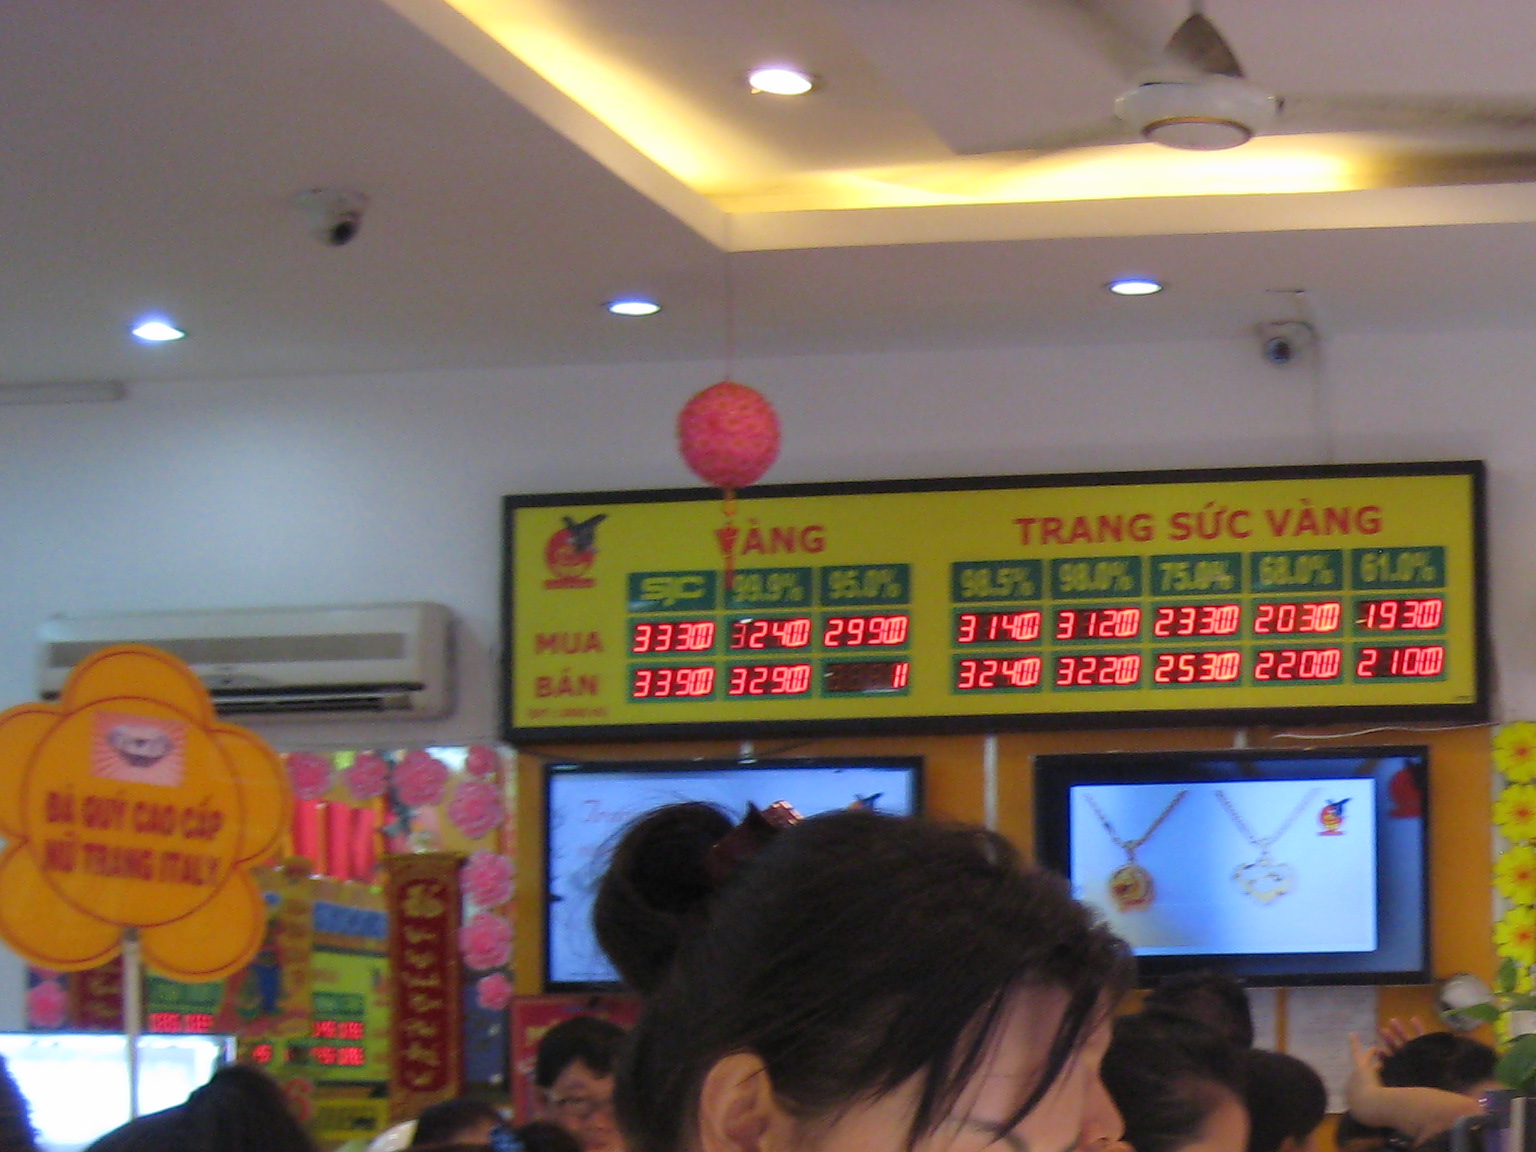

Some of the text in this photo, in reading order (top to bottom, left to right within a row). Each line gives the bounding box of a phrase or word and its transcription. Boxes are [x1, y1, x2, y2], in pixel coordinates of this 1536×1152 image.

[1013, 497, 1384, 546] TRANG SỨC VÀNG
[534, 631, 604, 655] MUA
[534, 667, 600, 698] BÁN
